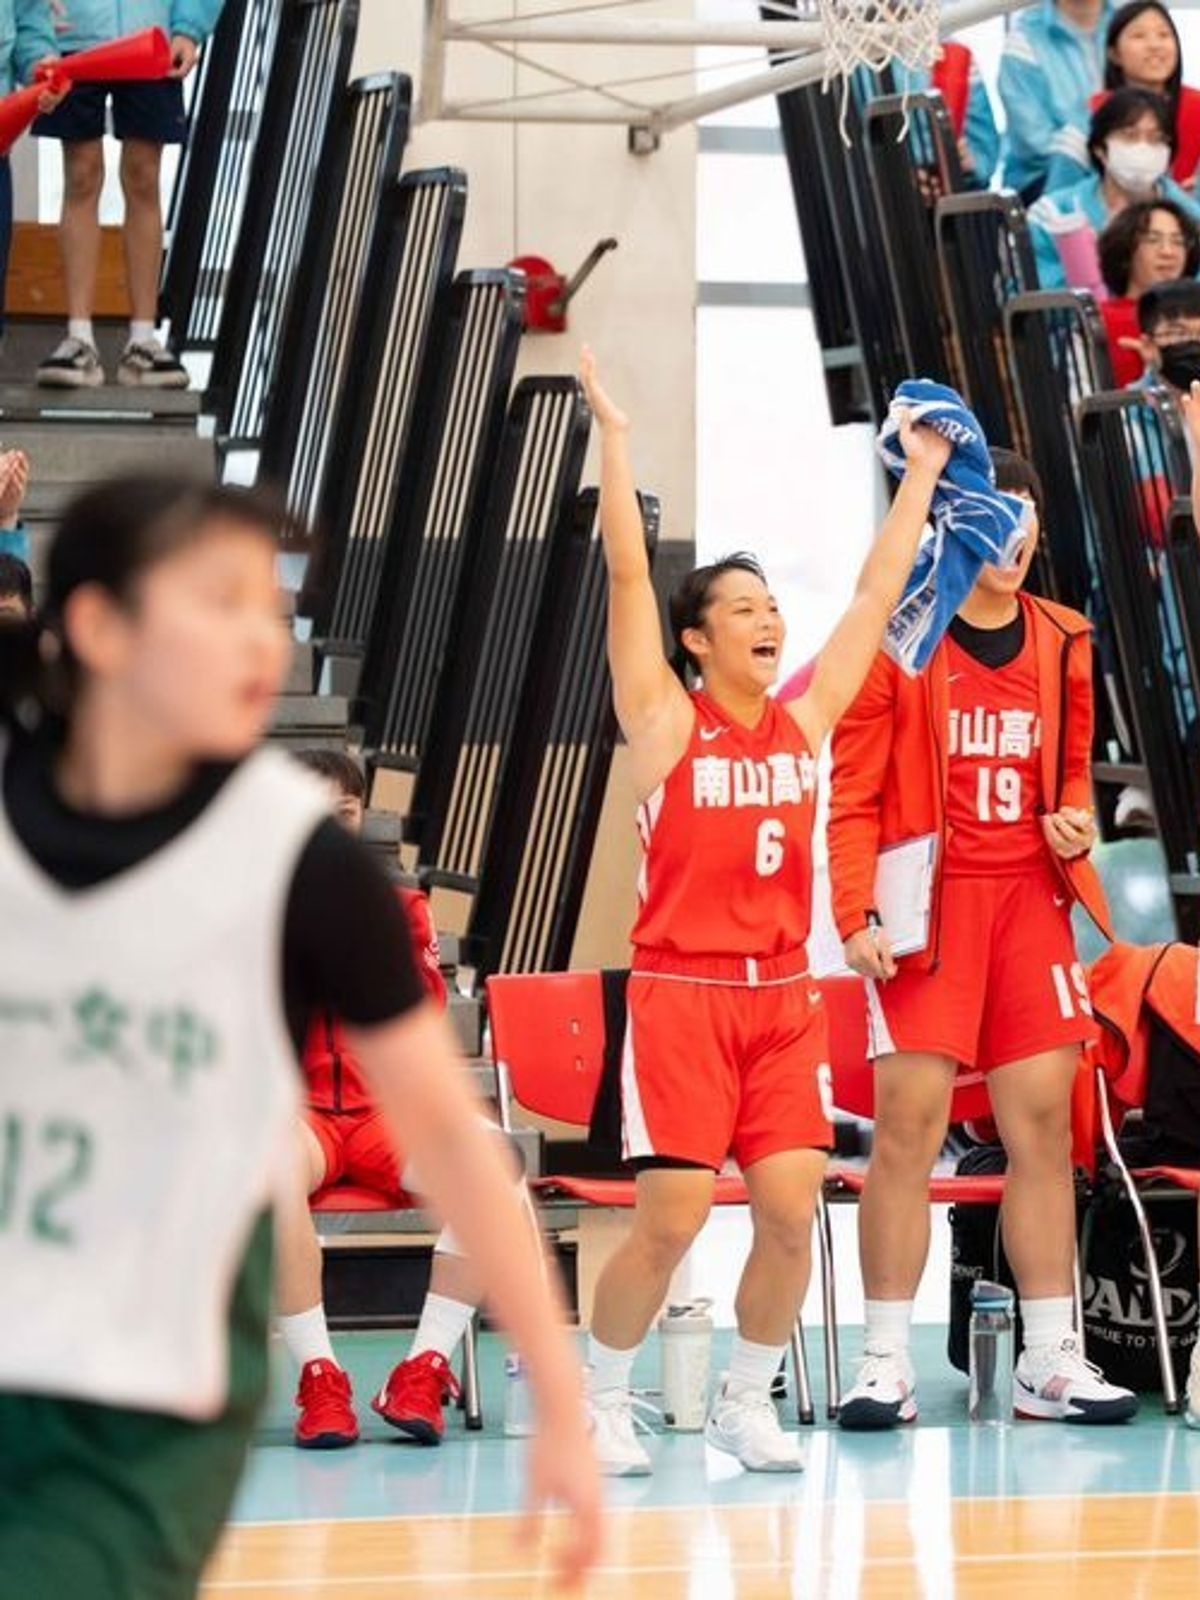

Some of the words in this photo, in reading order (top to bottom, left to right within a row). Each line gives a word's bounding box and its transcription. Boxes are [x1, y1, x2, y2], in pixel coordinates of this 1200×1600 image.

[976, 766, 1022, 823] 19
[755, 817, 787, 877] 6
[0, 1112, 94, 1243] 12
[1125, 1333, 1147, 1348] TO
